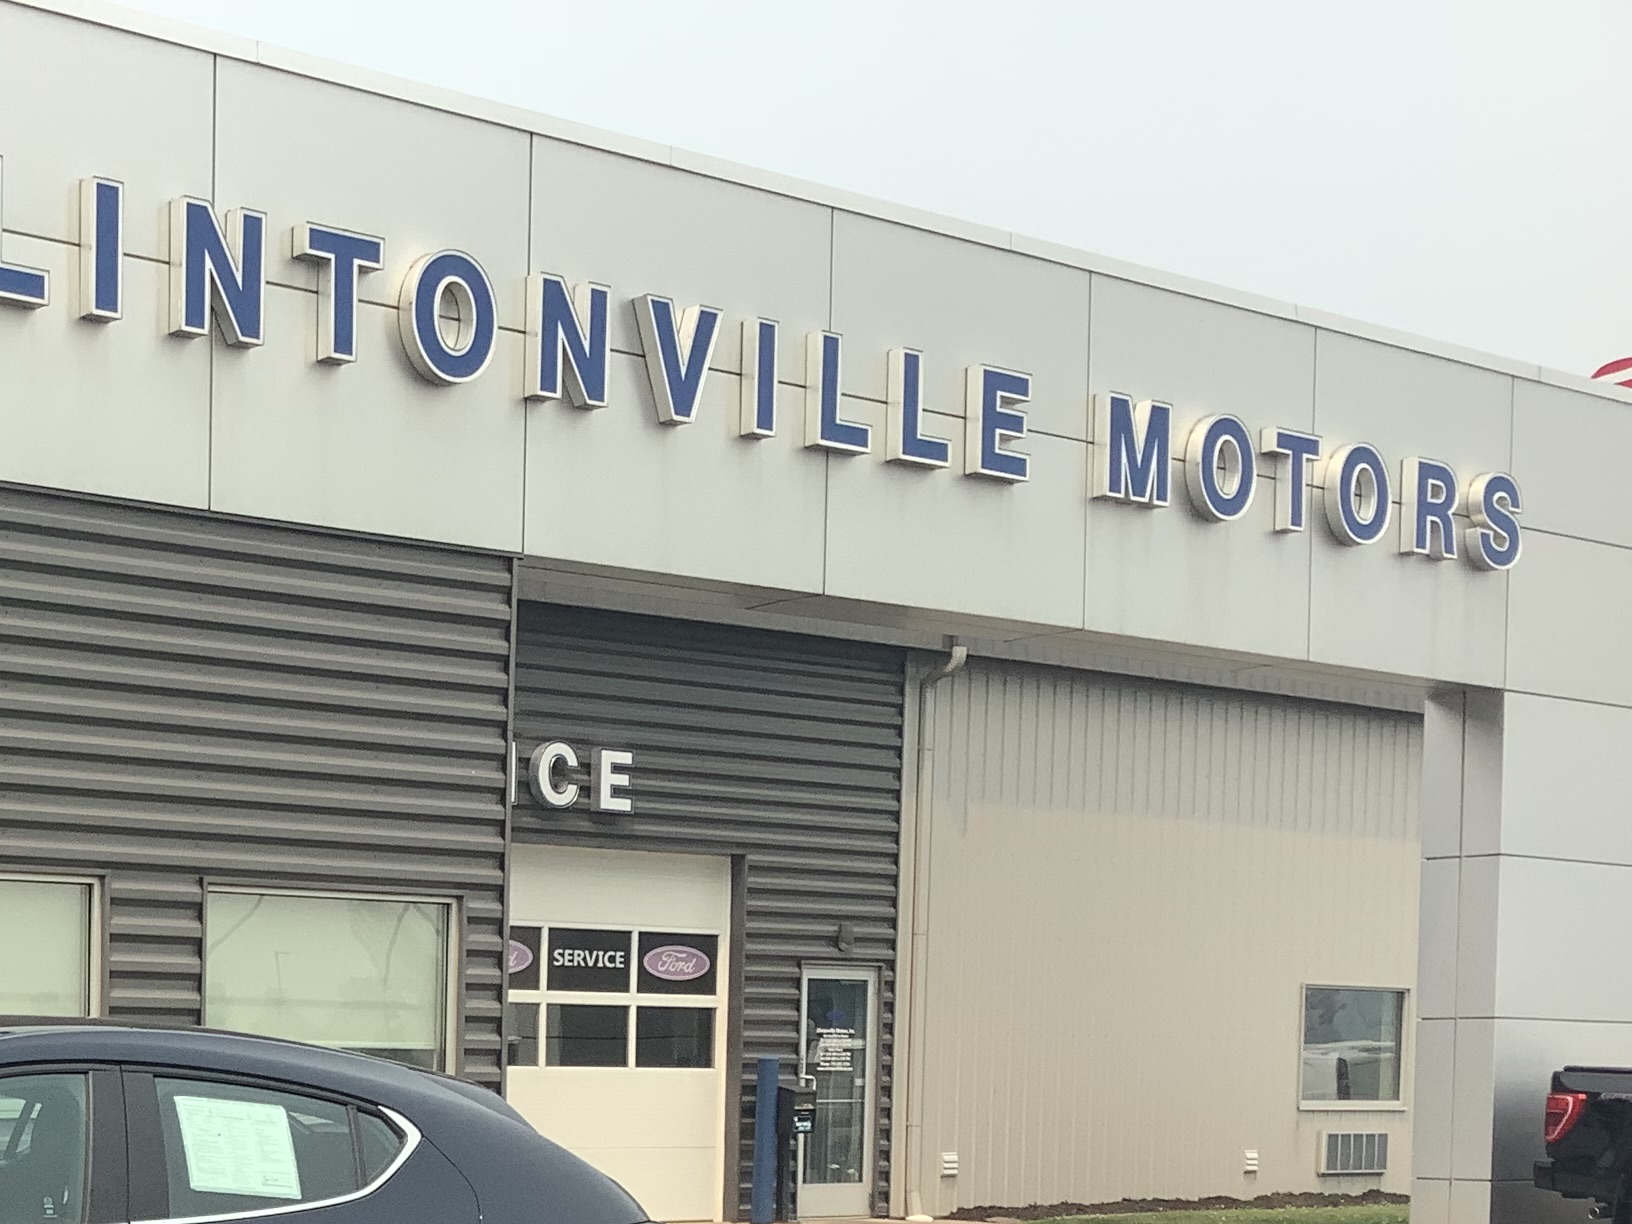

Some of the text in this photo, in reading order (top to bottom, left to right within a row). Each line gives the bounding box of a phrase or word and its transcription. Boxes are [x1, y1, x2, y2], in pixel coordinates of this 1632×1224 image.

[1092, 390, 1523, 571] MOTORS
[553, 948, 625, 969] SERVICE
[656, 952, 696, 974] Ford
